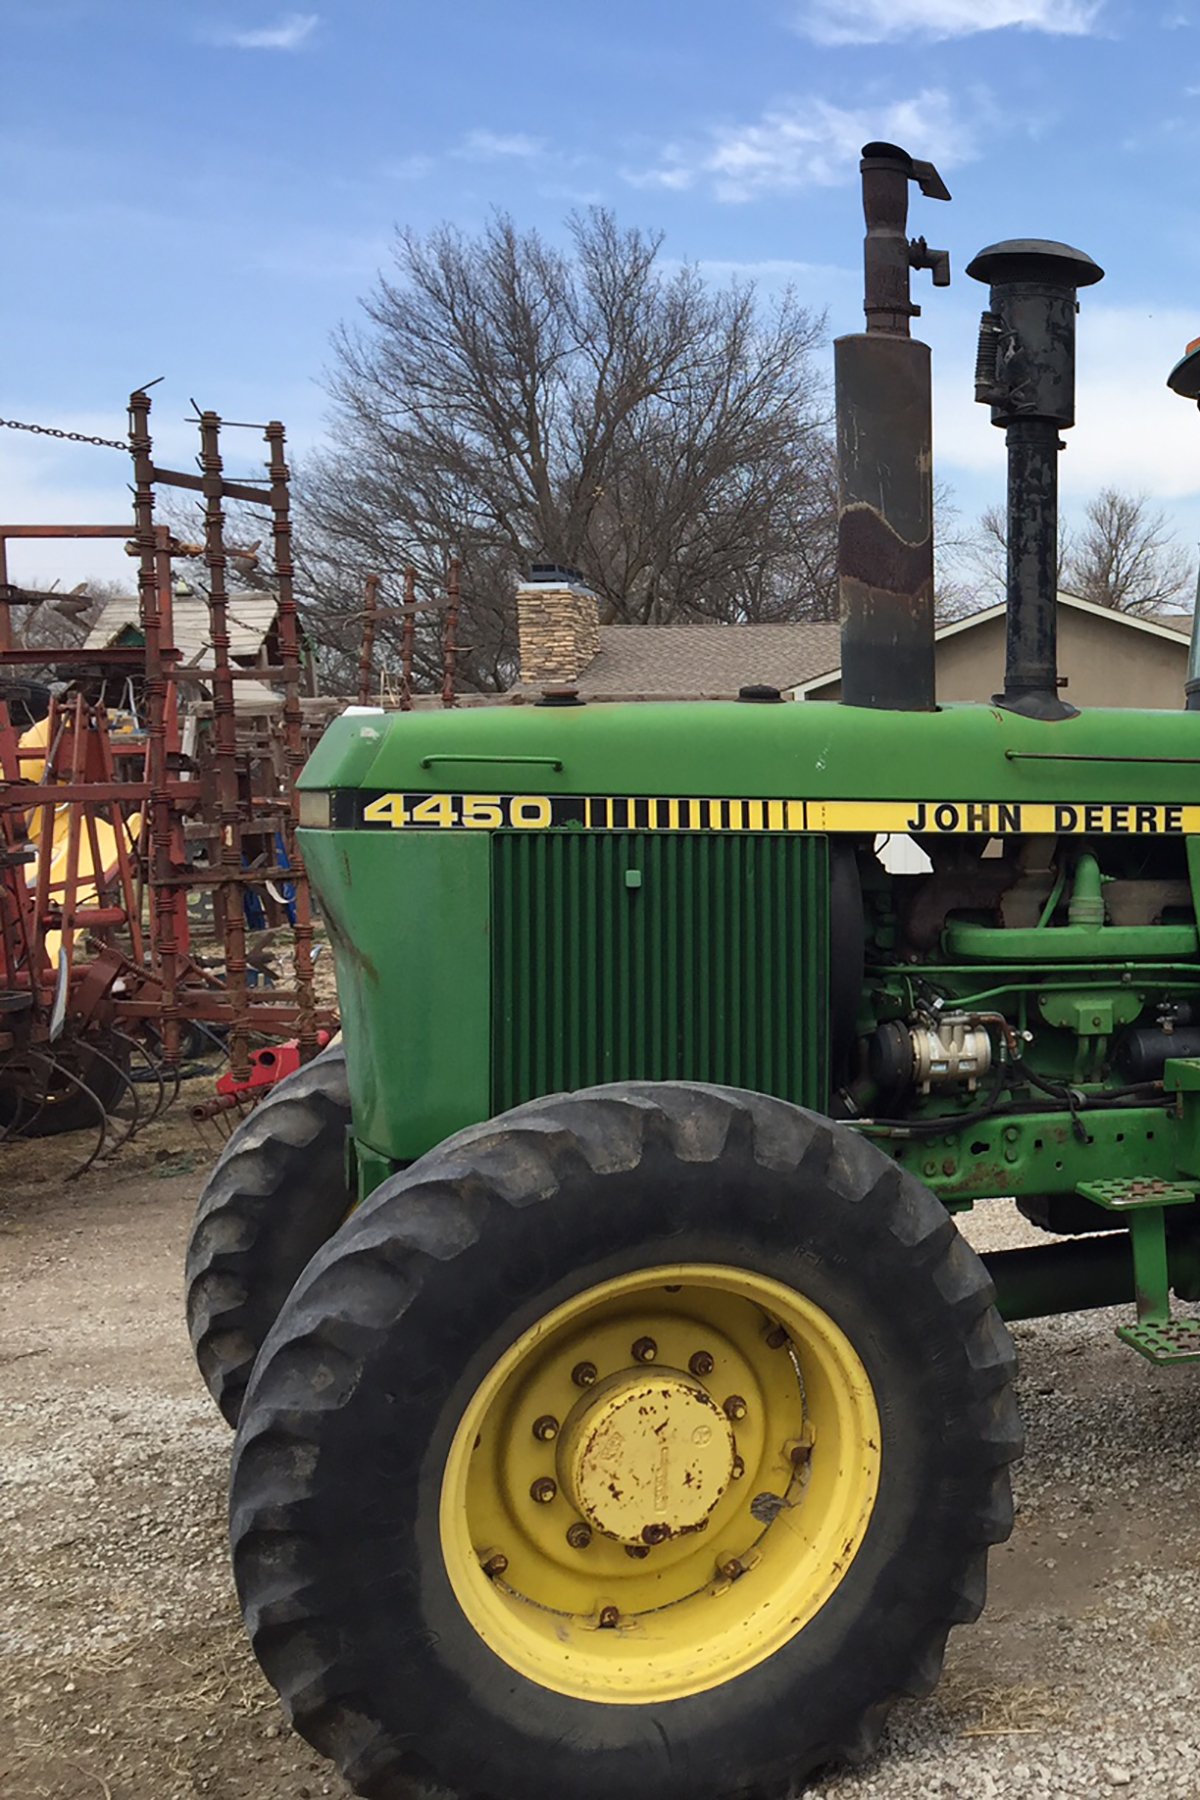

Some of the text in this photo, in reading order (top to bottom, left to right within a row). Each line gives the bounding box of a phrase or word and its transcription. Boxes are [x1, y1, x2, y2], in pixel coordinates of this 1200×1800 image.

[362, 792, 553, 829] 4450
[907, 803, 1184, 833] JOHN DEERE
